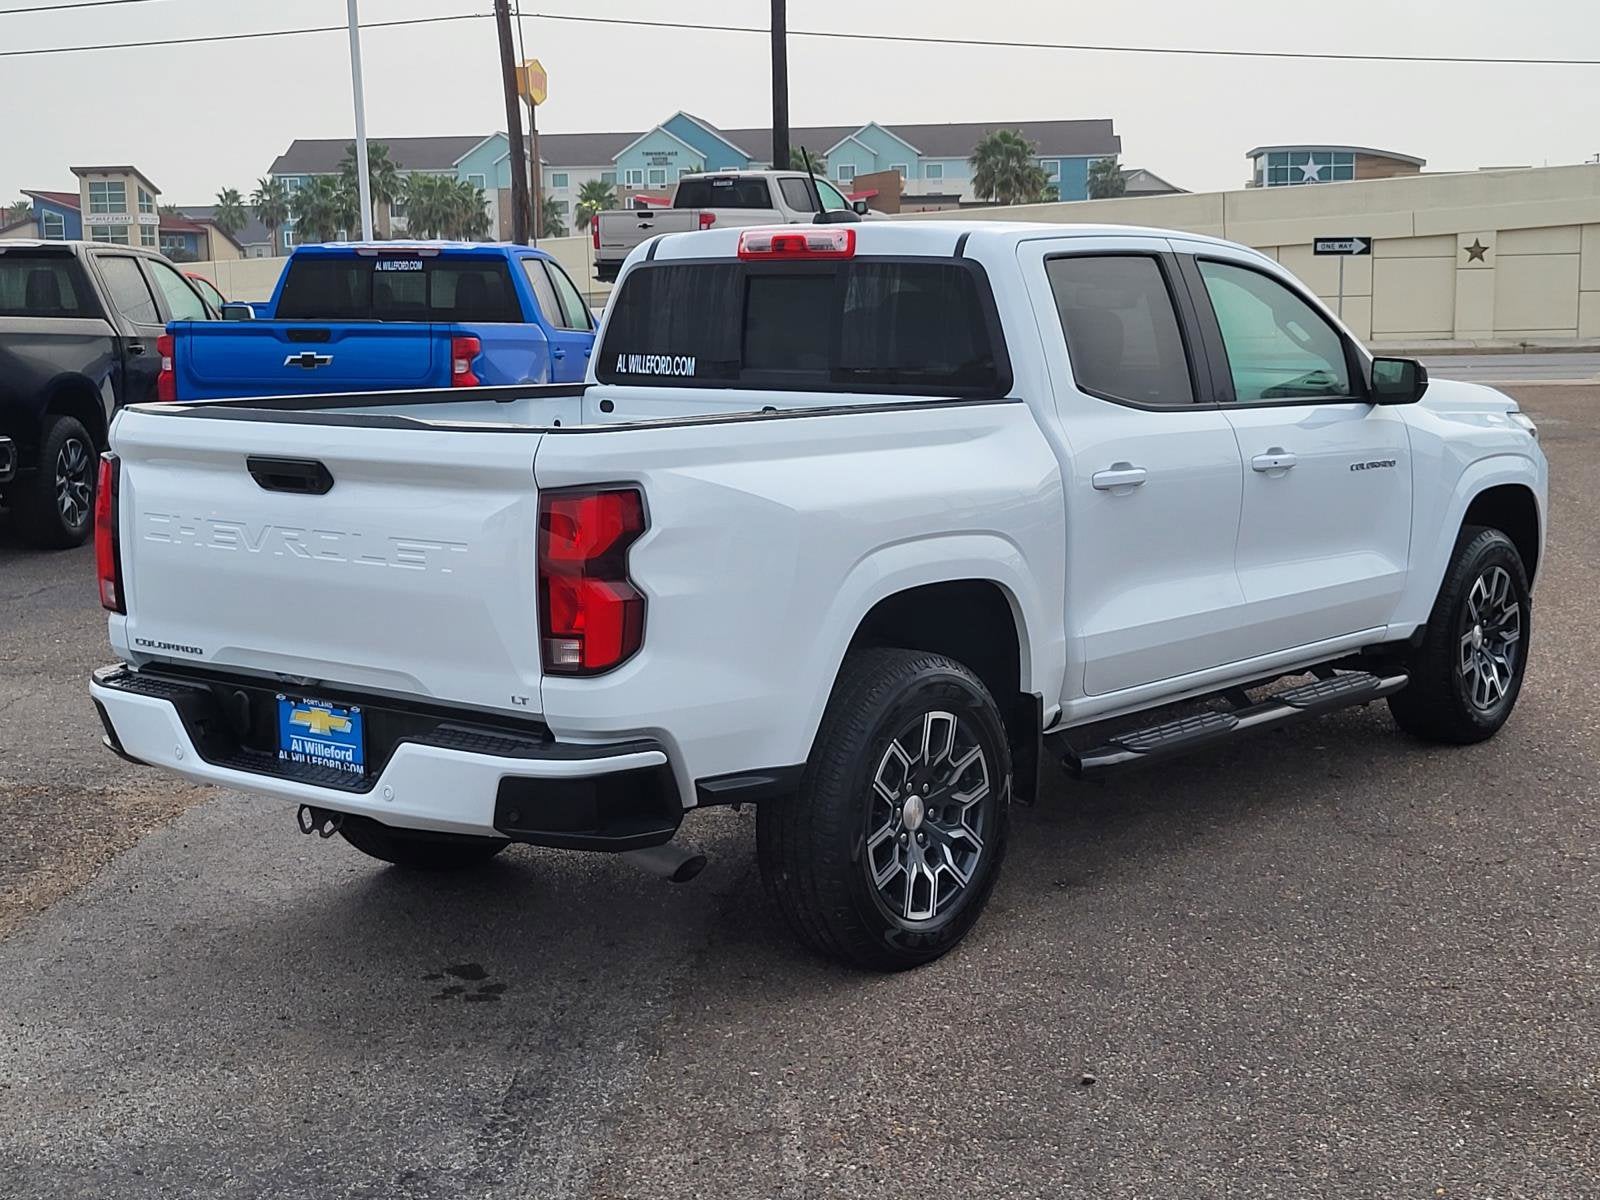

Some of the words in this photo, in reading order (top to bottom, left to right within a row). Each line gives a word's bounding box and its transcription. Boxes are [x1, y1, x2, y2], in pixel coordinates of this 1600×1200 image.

[375, 260, 382, 271] AL
[382, 260, 423, 271] WILLEFORD.COM
[615, 353, 627, 373] AL
[628, 354, 696, 377] WILLEFORD.COM
[1350, 459, 1396, 471] COLORADO
[143, 511, 468, 573] CHEVROLET
[135, 637, 203, 655] COLORADO
[302, 697, 334, 709] PORTLAND
[511, 695, 530, 706] LT
[291, 738, 303, 753] Al
[303, 740, 353, 762] Willeford
[278, 750, 290, 760] AL
[291, 751, 364, 775] WILLEFORD.COM
